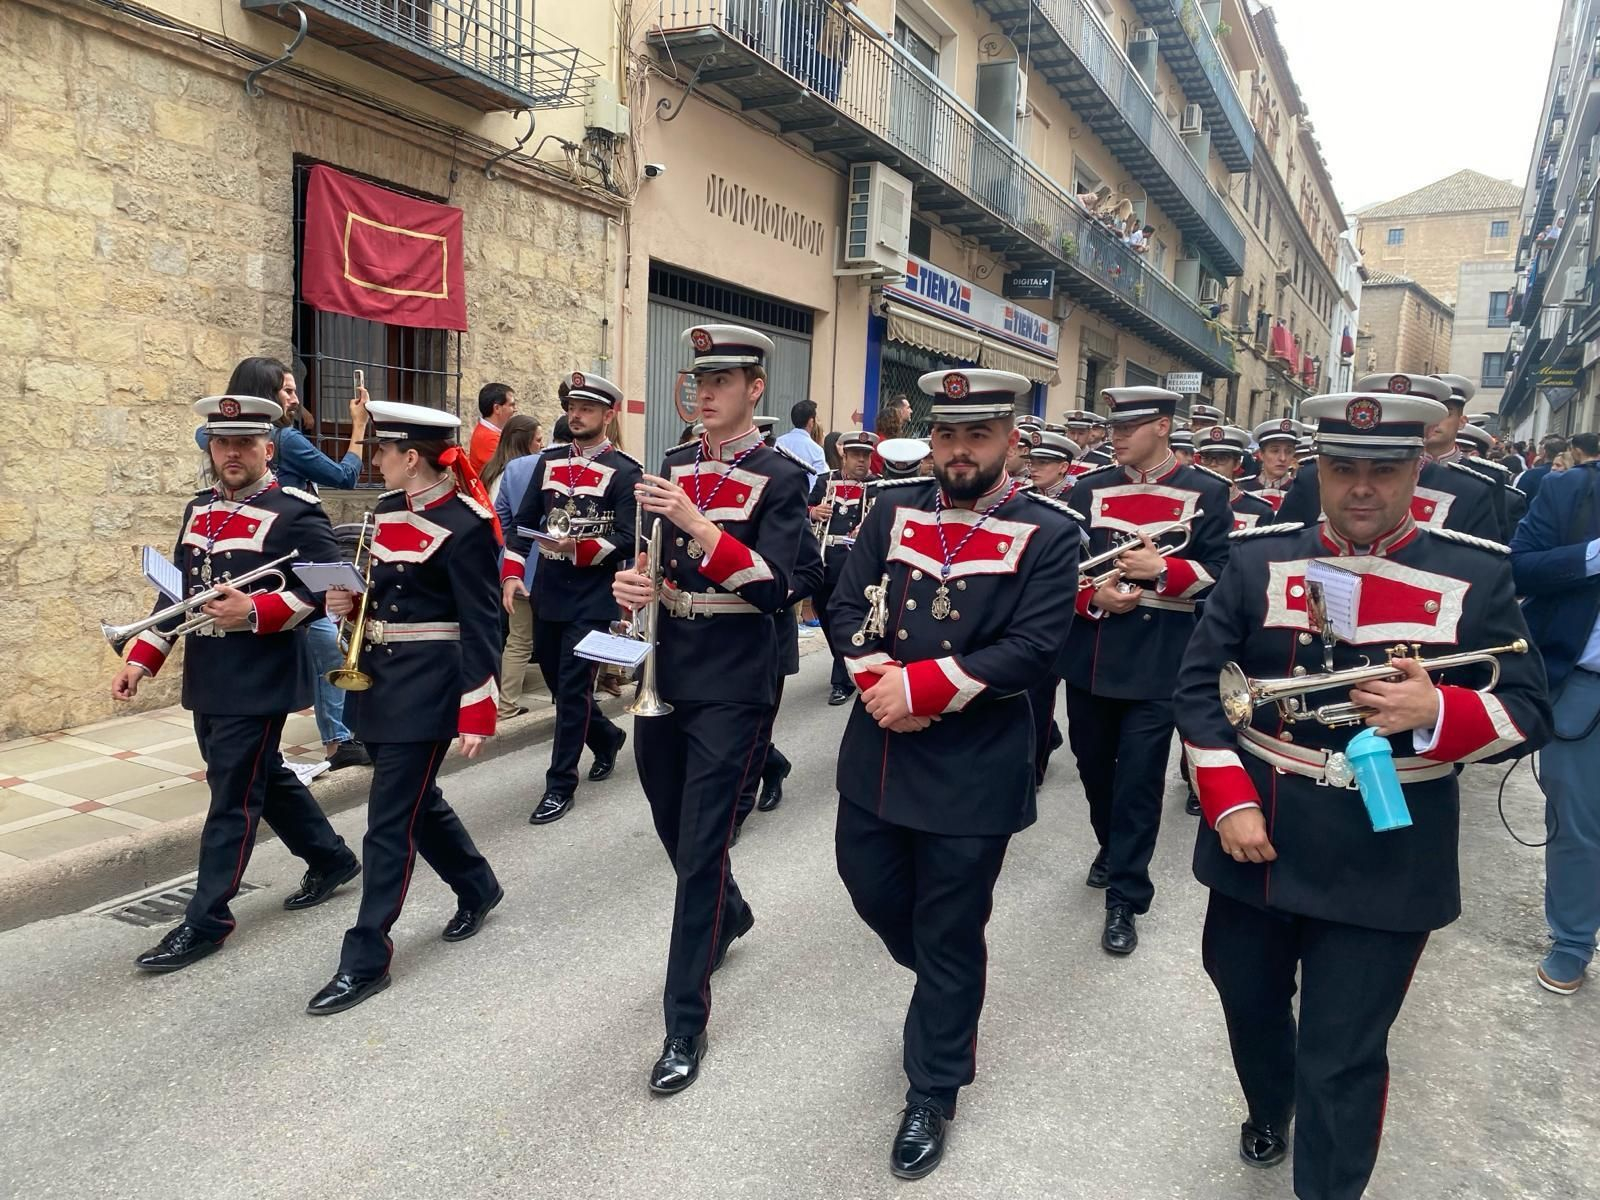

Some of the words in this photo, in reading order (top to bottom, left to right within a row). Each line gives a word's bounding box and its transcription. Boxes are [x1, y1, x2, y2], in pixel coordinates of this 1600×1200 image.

[920, 266, 949, 305] TIEN
[1013, 278, 1049, 286] DIGITAL+
[1013, 310, 1034, 339] TIEN
